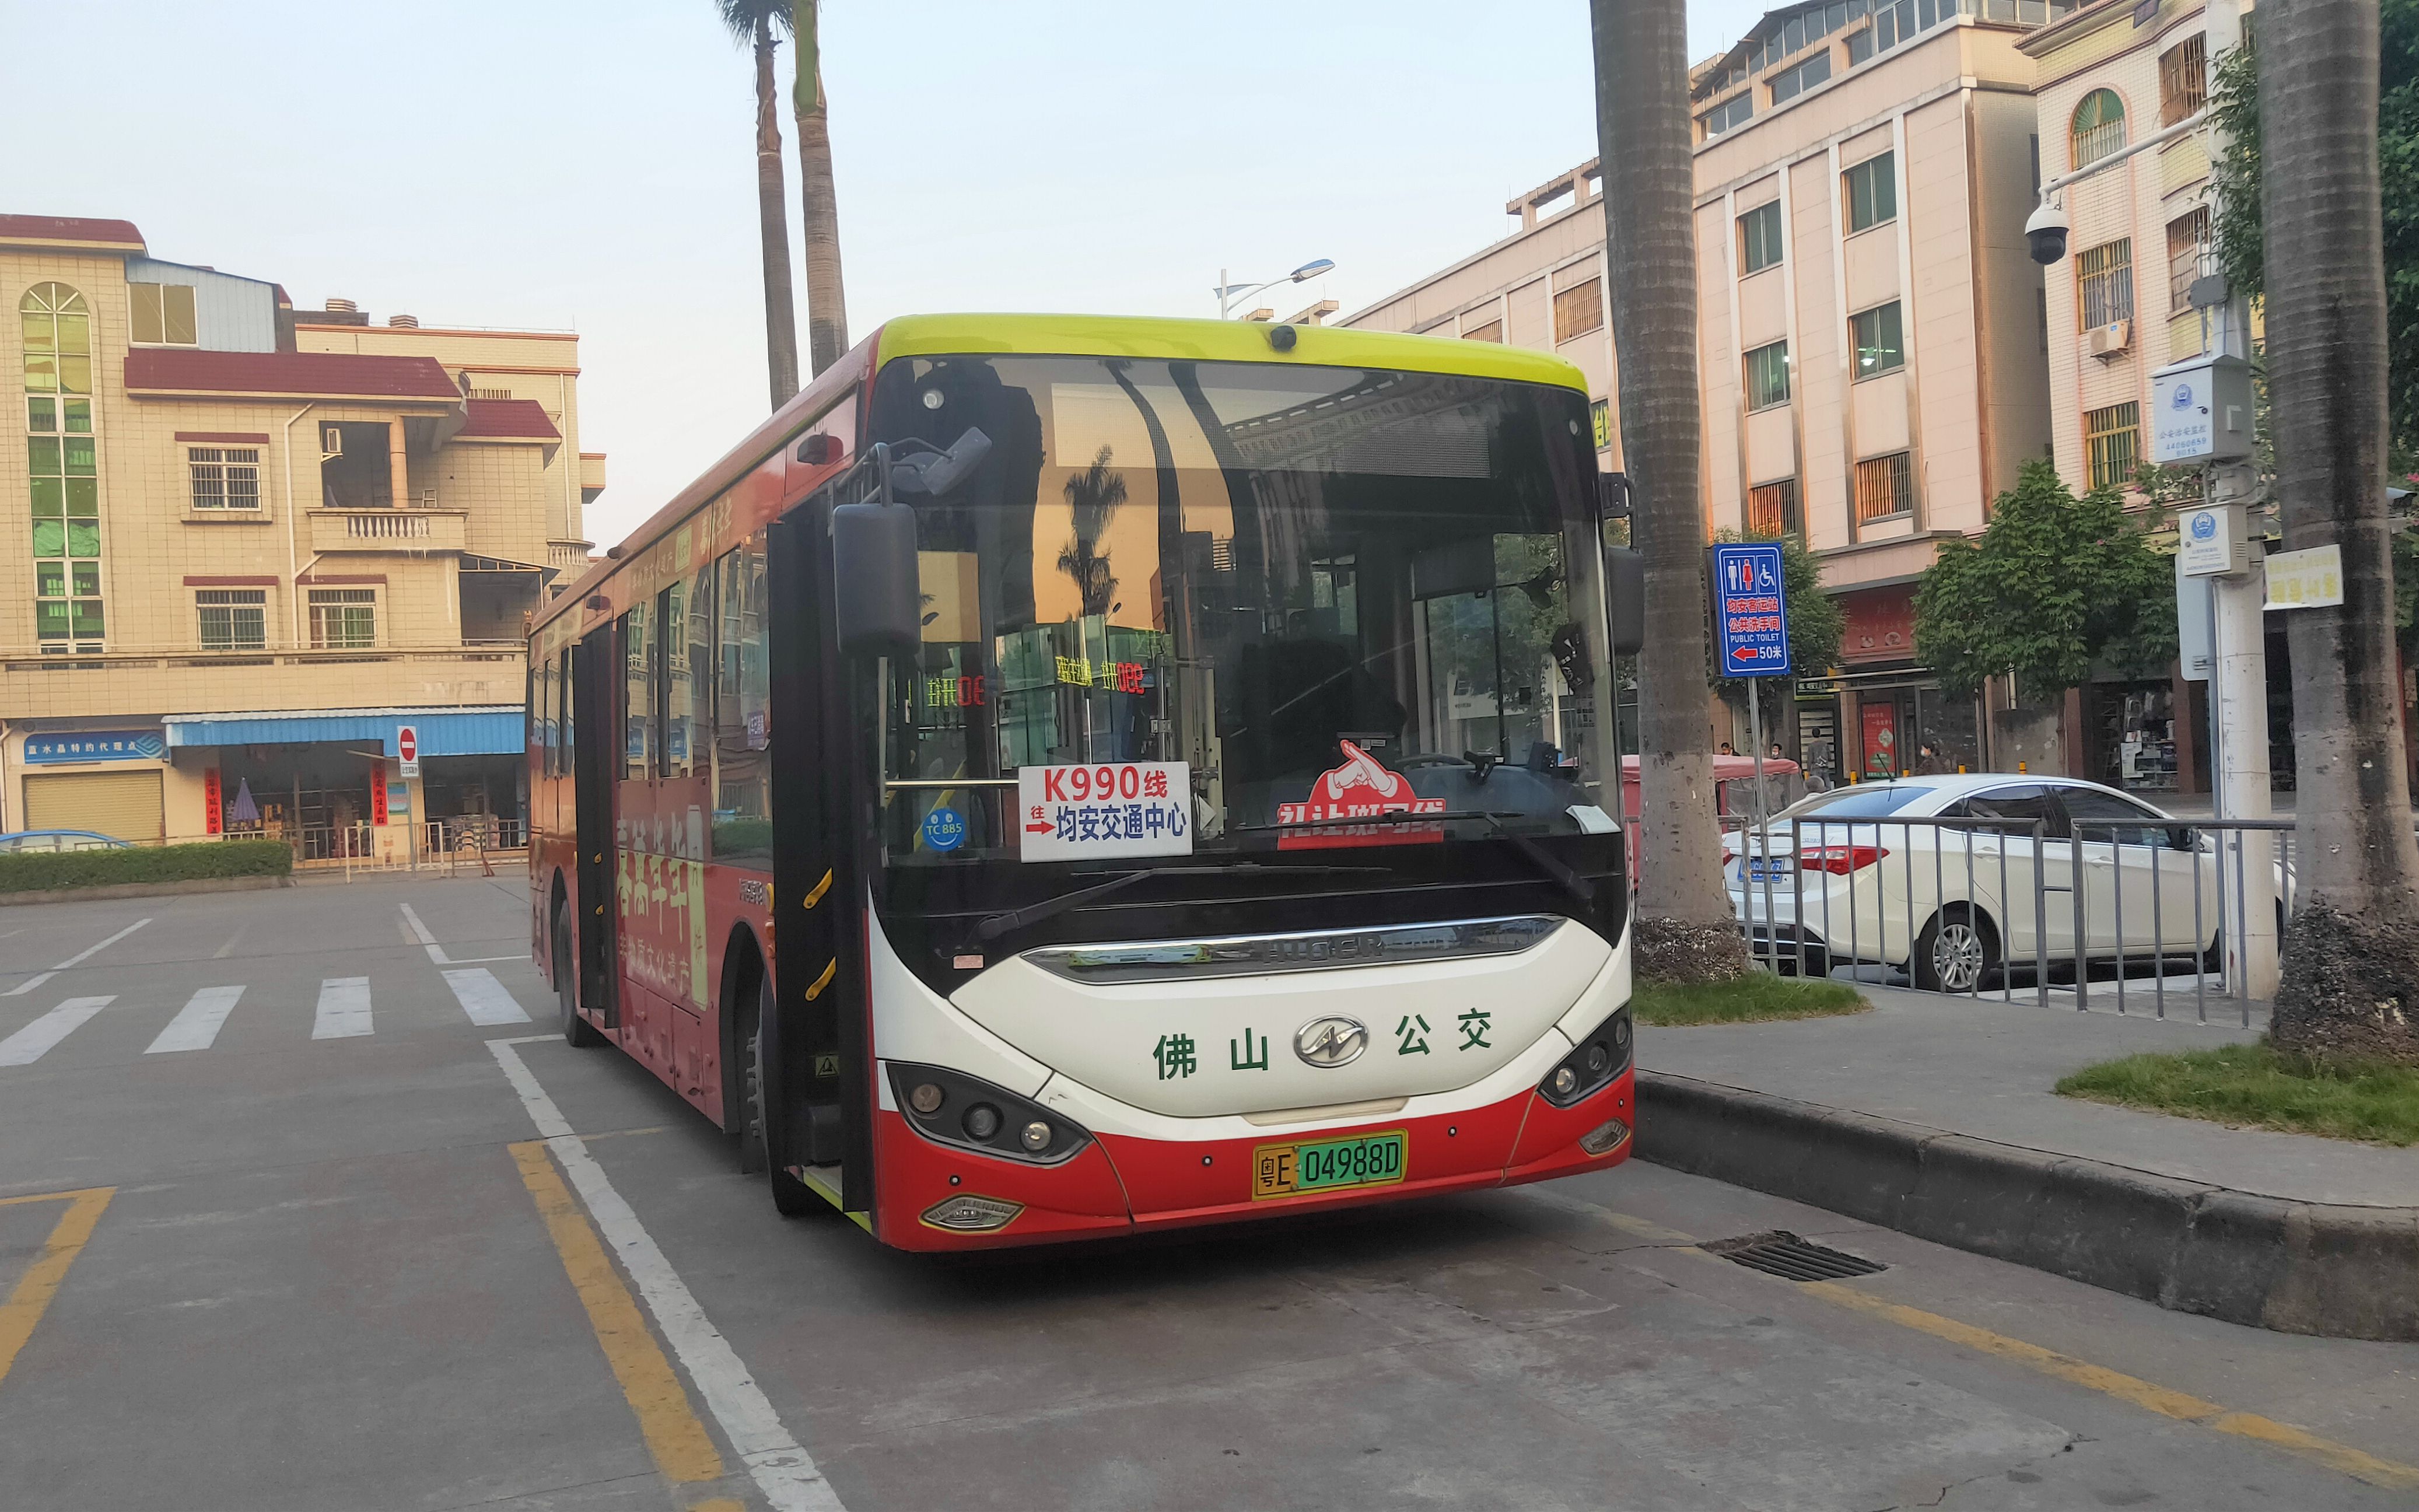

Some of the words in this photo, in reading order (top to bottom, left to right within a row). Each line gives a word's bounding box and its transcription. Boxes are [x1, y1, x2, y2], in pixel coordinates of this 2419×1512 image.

[1727, 596, 1779, 613] 均安客运站
[1728, 615, 1780, 633] 公共洗手间
[1730, 635, 1755, 643] PUBLIC
[1759, 645, 1782, 659] 50米
[29, 741, 137, 755] 蓝水晶特约代理点
[1045, 765, 1168, 802] K990线
[1031, 806, 1045, 819] 往
[1280, 802, 1444, 838] 礼让斑马线
[926, 825, 940, 835] TC
[942, 823, 962, 834] 885
[1056, 802, 1187, 842] 均安交通中心
[1263, 933, 1384, 964] HIGER
